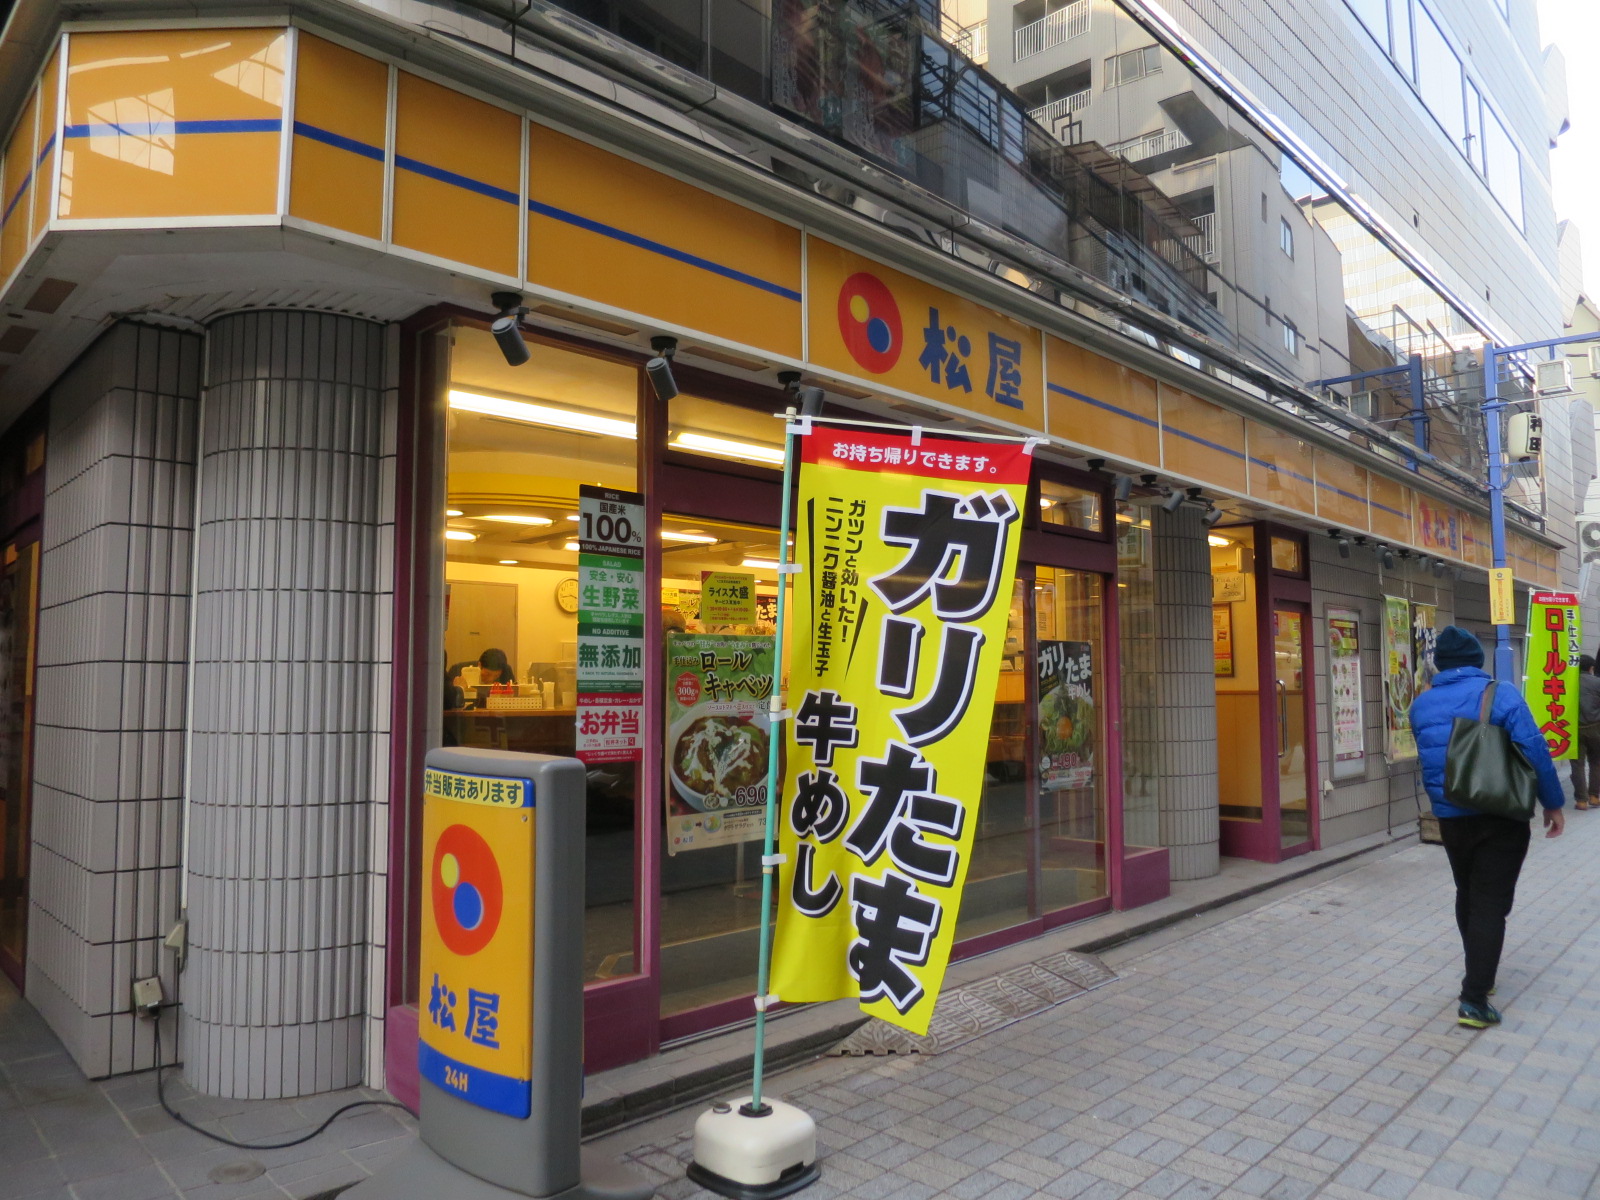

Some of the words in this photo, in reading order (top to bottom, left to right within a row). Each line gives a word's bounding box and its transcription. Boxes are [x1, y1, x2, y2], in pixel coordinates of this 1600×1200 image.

[918, 306, 1024, 411] 松屋
[832, 442, 997, 474] お持ち帰りできます。
[599, 502, 626, 516] 国産米
[604, 492, 620, 500] RICE
[582, 512, 641, 543] 100%
[582, 543, 598, 551] 100%
[597, 546, 627, 555] JAPANESE
[627, 548, 641, 556] RICE
[589, 570, 634, 584] 安全・安心
[602, 560, 621, 568] SALAD
[582, 584, 640, 609] 生野菜
[709, 586, 749, 599] ライス大盛
[815, 496, 844, 678] ニンニク醤油と生玉子
[579, 643, 641, 669] 無添加
[1037, 642, 1092, 685] ガリたま
[704, 673, 773, 702] キャベツ
[1540, 608, 1571, 759] ロールキャベツ
[580, 709, 639, 736] お弁当
[842, 488, 1020, 1015] ガリたま
[735, 785, 768, 806] 690
[790, 689, 859, 918] 牛めし
[428, 973, 500, 1049] 松屋
[445, 1065, 468, 1093] 24H
